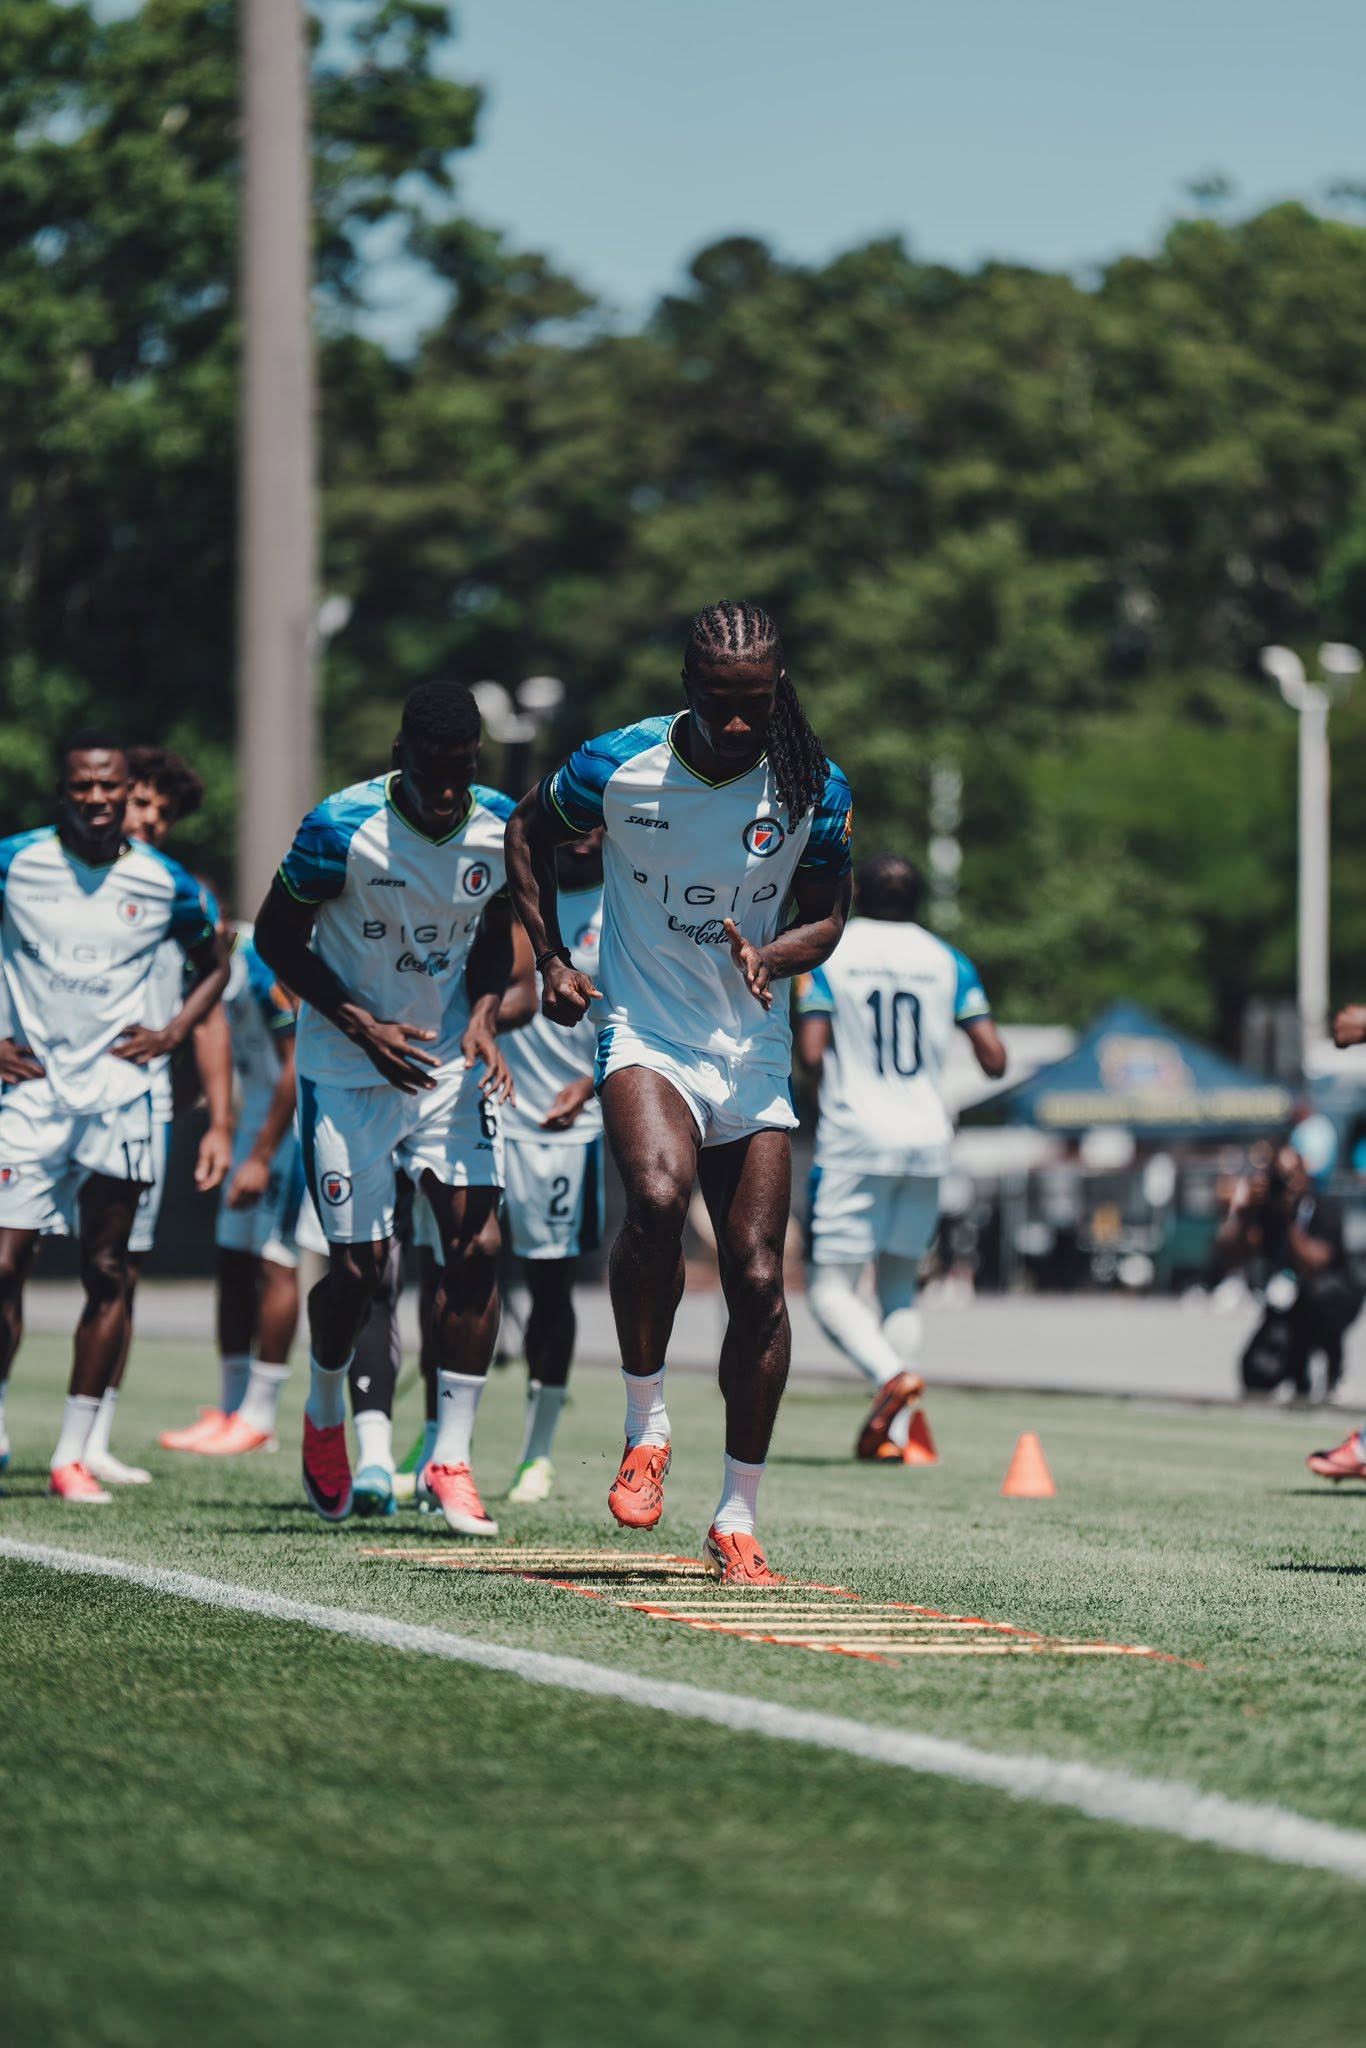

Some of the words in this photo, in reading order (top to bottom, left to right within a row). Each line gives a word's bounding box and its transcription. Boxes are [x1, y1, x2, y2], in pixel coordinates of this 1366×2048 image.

[624, 815, 669, 830] SAETA
[668, 915, 741, 945] Cca-Cola
[866, 990, 922, 1076] 10
[478, 1098, 497, 1140] 6
[549, 1176, 570, 1217] 2
